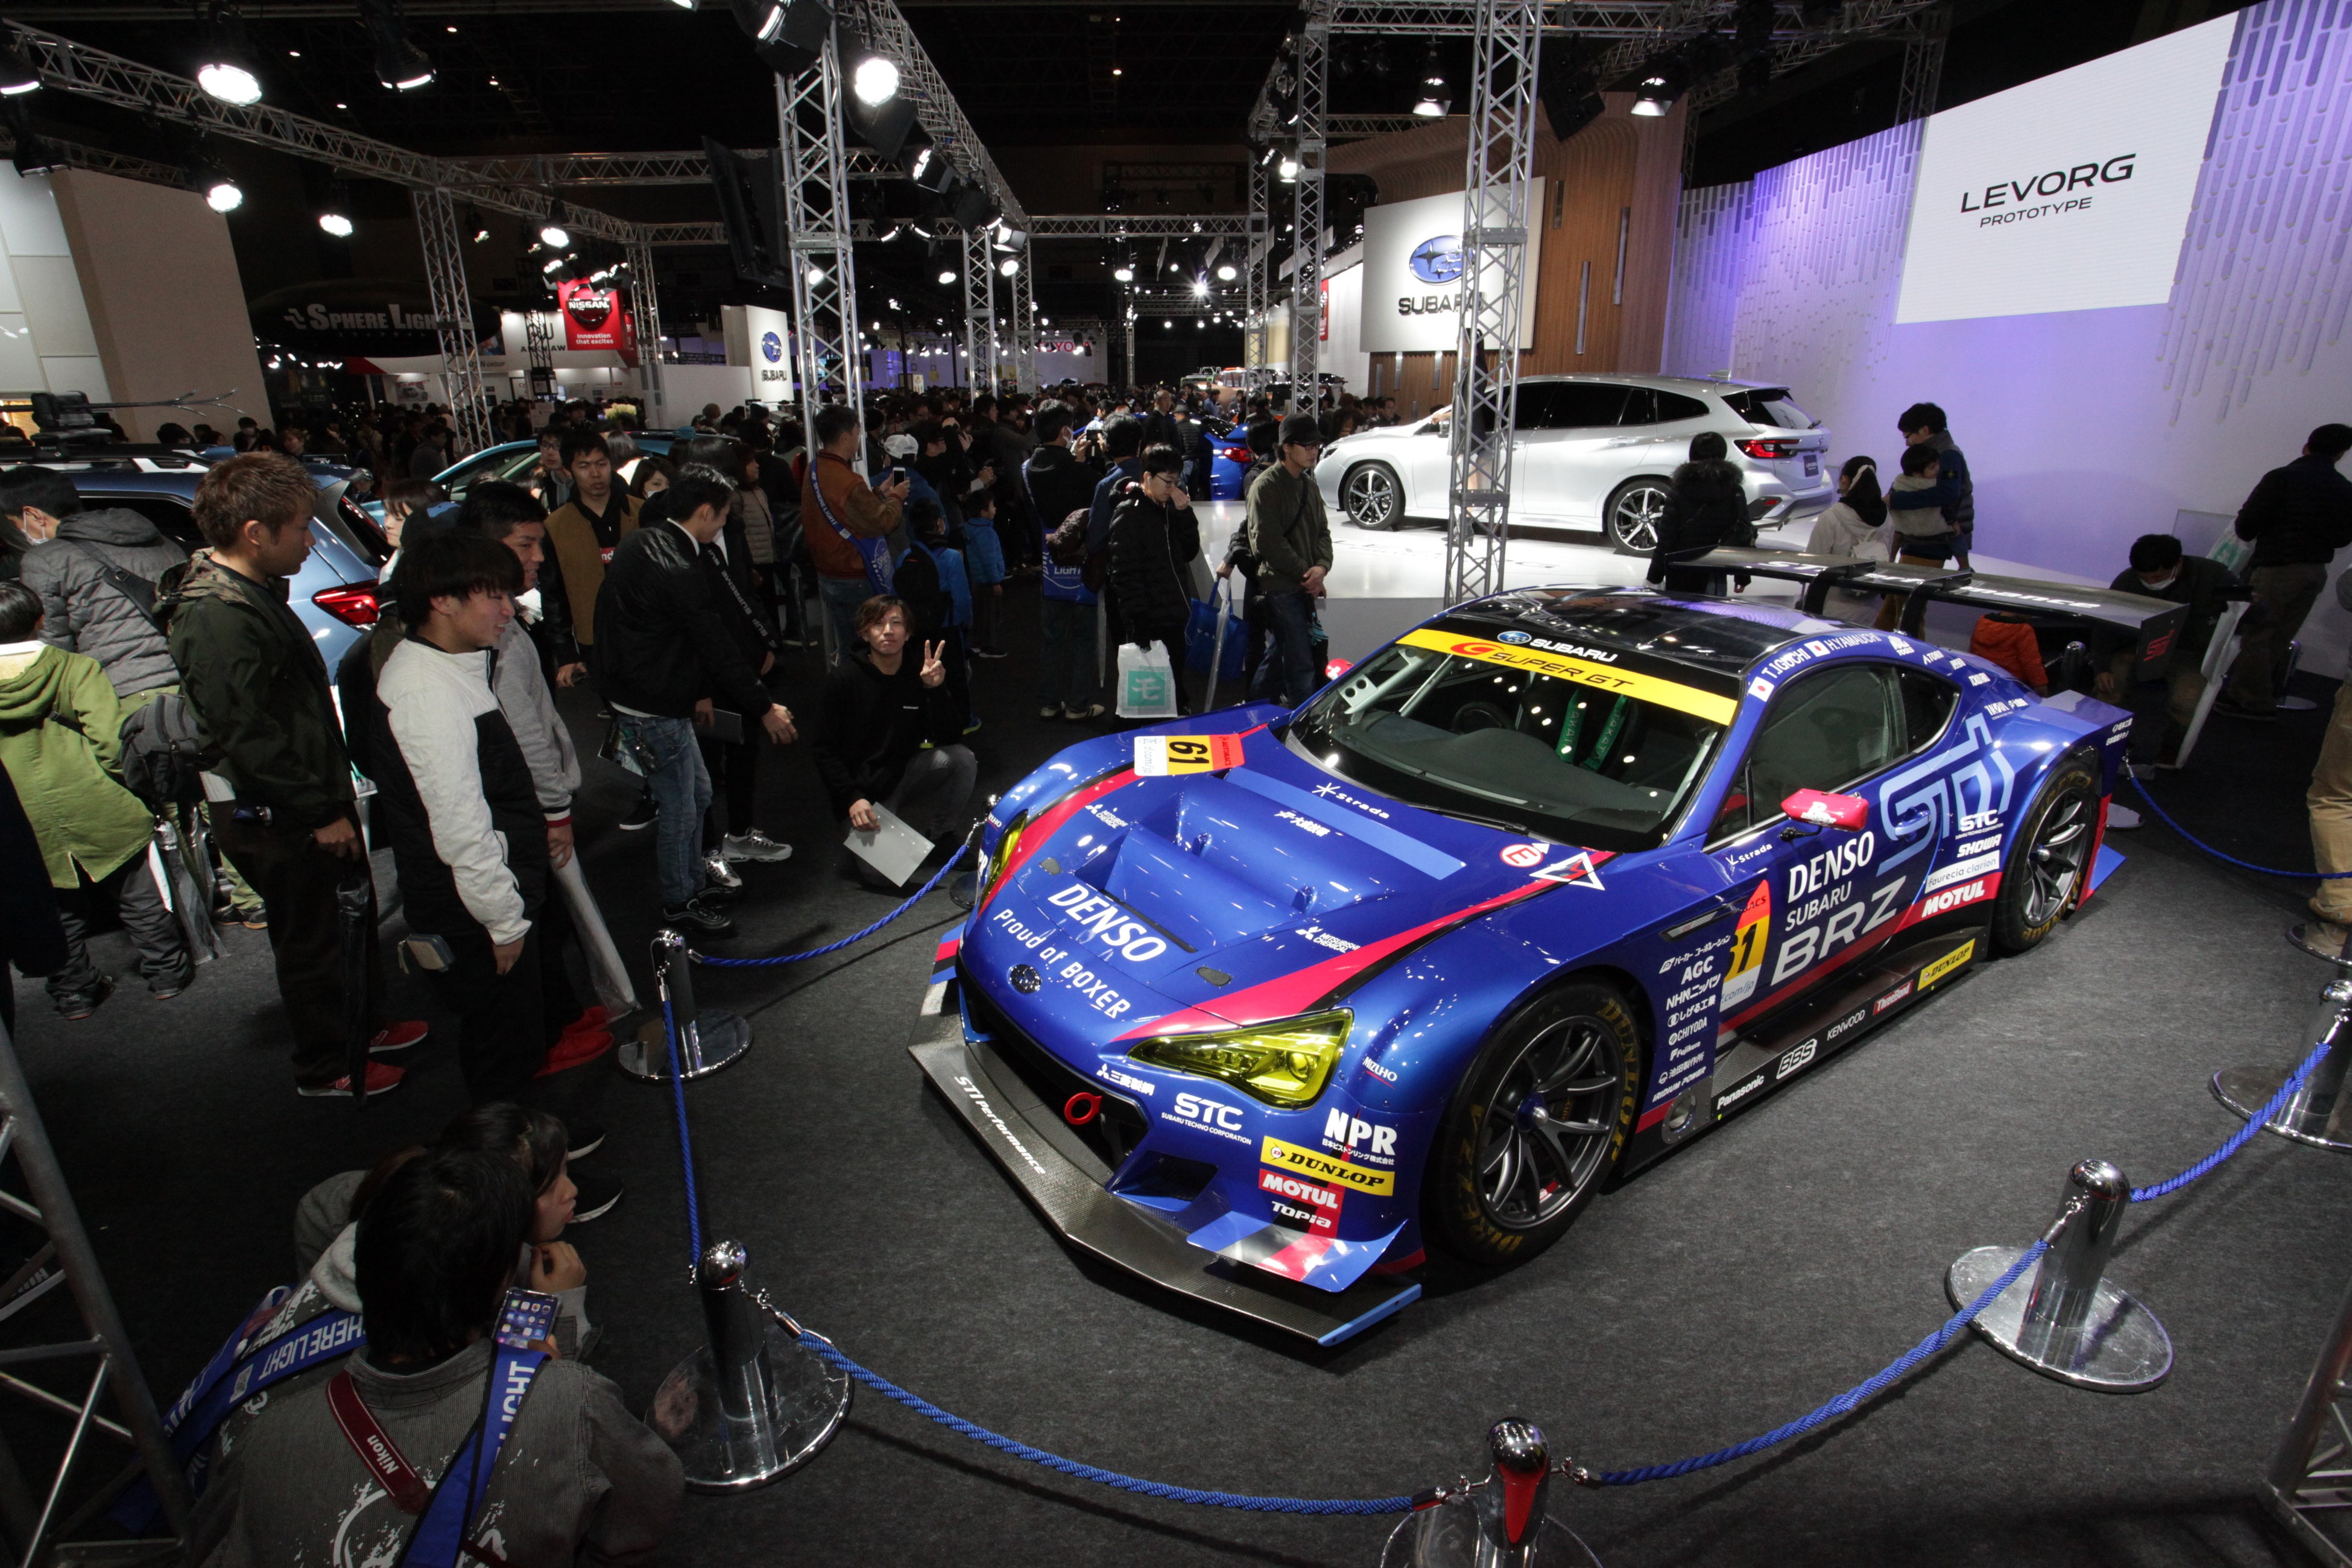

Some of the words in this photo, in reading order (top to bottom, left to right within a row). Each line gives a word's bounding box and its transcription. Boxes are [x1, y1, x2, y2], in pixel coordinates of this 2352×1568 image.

[1961, 153, 2137, 213] LEVORG
[1980, 197, 2093, 228] PROTOTYPE
[308, 304, 388, 330] SPHERE
[569, 301, 607, 309] NISSAN
[762, 368, 787, 382] SUBARU
[822, 507, 837, 525] LIGHT
[1529, 638, 1619, 663] SUBARU
[1823, 633, 1882, 651] H.YAMAUCHI
[1487, 651, 1585, 678] SUPER
[1584, 674, 1634, 689] GT
[1762, 648, 1812, 679] T.IGUCHI
[1562, 706, 1580, 753] TAKAT
[1168, 741, 1210, 764] 61
[1336, 791, 1389, 819] strada
[1960, 809, 1998, 832] STC
[1739, 844, 1772, 863] strada
[1957, 833, 2002, 858] SHOWA
[1788, 831, 1874, 903] DENSO
[1929, 868, 1965, 887] faurecia
[1967, 858, 1997, 874] clarion
[1785, 881, 1852, 931] SUBARU
[1921, 880, 1985, 917] MOTUL
[1048, 884, 1167, 961] DENSO
[1771, 875, 1907, 986] BRZ
[993, 909, 1048, 949] Proud
[1039, 945, 1068, 965] of
[1060, 961, 1131, 1019] BOXER
[1681, 955, 1714, 985] AGC
[1930, 947, 1971, 977] DUNLOP
[1666, 973, 1721, 1011] NHKニッパツ
[1876, 984, 1911, 1013] ThreeBond
[1677, 1017, 1707, 1042] CHIYODA
[1827, 1010, 1865, 1041] KENWOOD
[1677, 1042, 1701, 1058] Fujikura
[1776, 1038, 1817, 1080] BBS
[1362, 1057, 1397, 1082] MIZUHO
[1652, 1081, 1681, 1103] IRIDIUM
[1681, 1066, 1706, 1086] POWER
[954, 1076, 984, 1098] STI
[1717, 1075, 1764, 1110] Panasonic
[1174, 1093, 1243, 1131] STC
[1161, 1112, 1184, 1124] SUBARU
[1184, 1119, 1209, 1132] TECHNO
[1209, 1125, 1251, 1145] CORPORATION
[1324, 1107, 1397, 1155] NPR
[1322, 1138, 1394, 1165] 日本ピストンリング株式会社
[1288, 1152, 1385, 1187] DUNLOP
[1262, 1174, 1338, 1209] MOTUL
[308, 1314, 365, 1356] HERE
[258, 1333, 307, 1380] LIGHT
[500, 1360, 536, 1442] IGHT
[367, 1434, 399, 1475] Nikon
